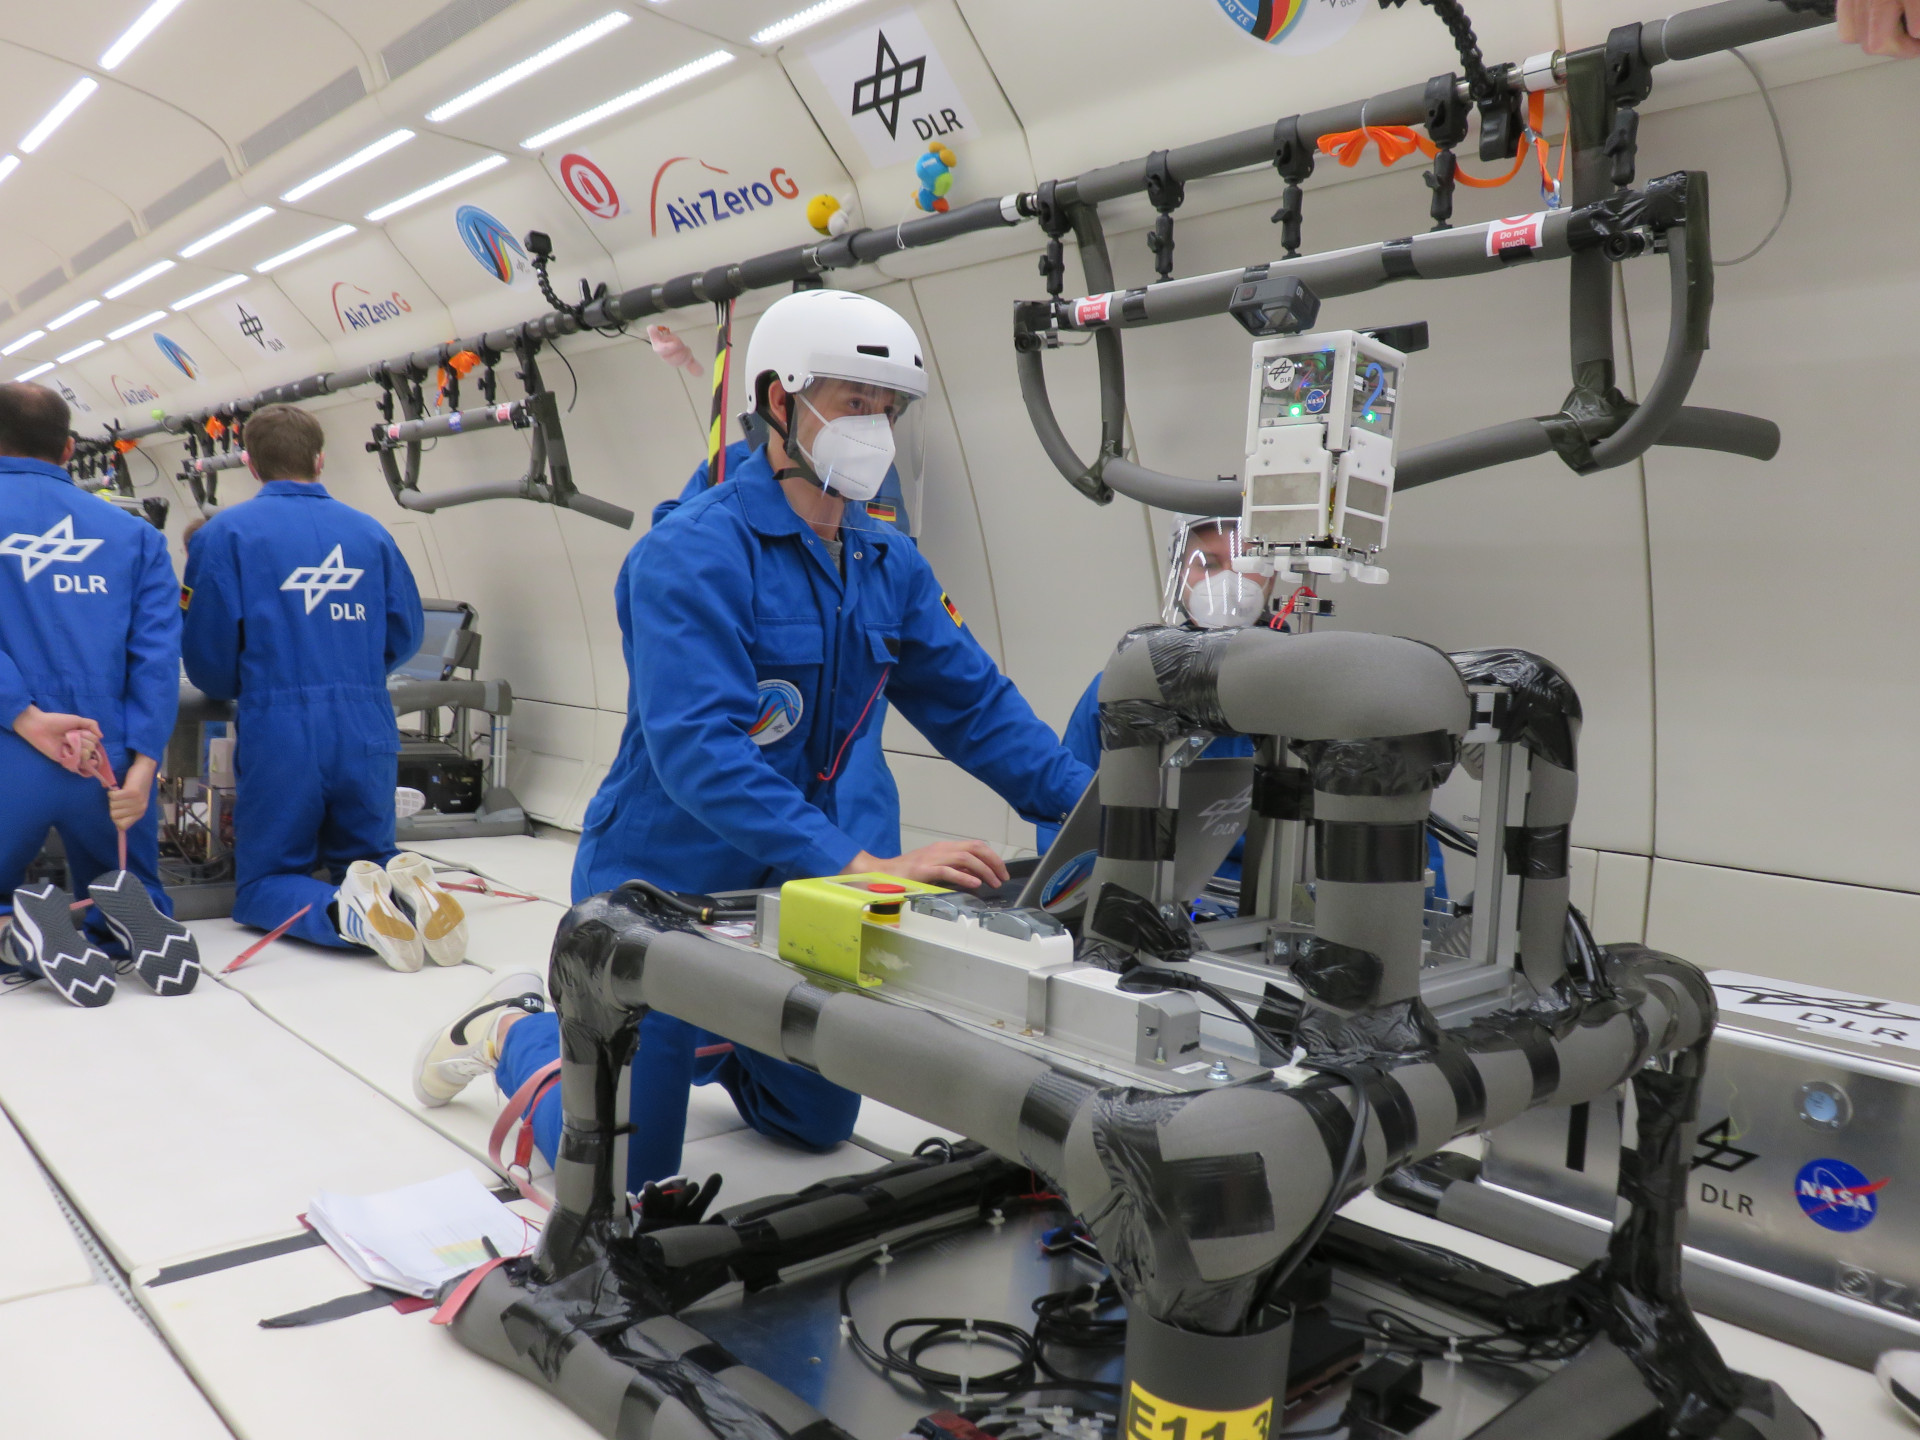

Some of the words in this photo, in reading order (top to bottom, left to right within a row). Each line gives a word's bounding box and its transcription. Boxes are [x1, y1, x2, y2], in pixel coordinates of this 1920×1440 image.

[911, 108, 964, 141] DLR
[666, 167, 800, 233] AirZeroG
[1500, 231, 1512, 240] Do
[1513, 228, 1529, 237] not
[1501, 238, 1526, 248] touch
[344, 291, 412, 331] AirZeroG
[267, 338, 287, 352] DLR
[1279, 376, 1293, 384] DLR
[1307, 397, 1325, 405] NASA
[53, 574, 109, 594] DLR
[329, 602, 367, 621] DLR
[1212, 822, 1240, 836] DLR
[1797, 1012, 1910, 1042] DLR
[1701, 1182, 1754, 1217] DLR
[1800, 1178, 1873, 1213] NASA
